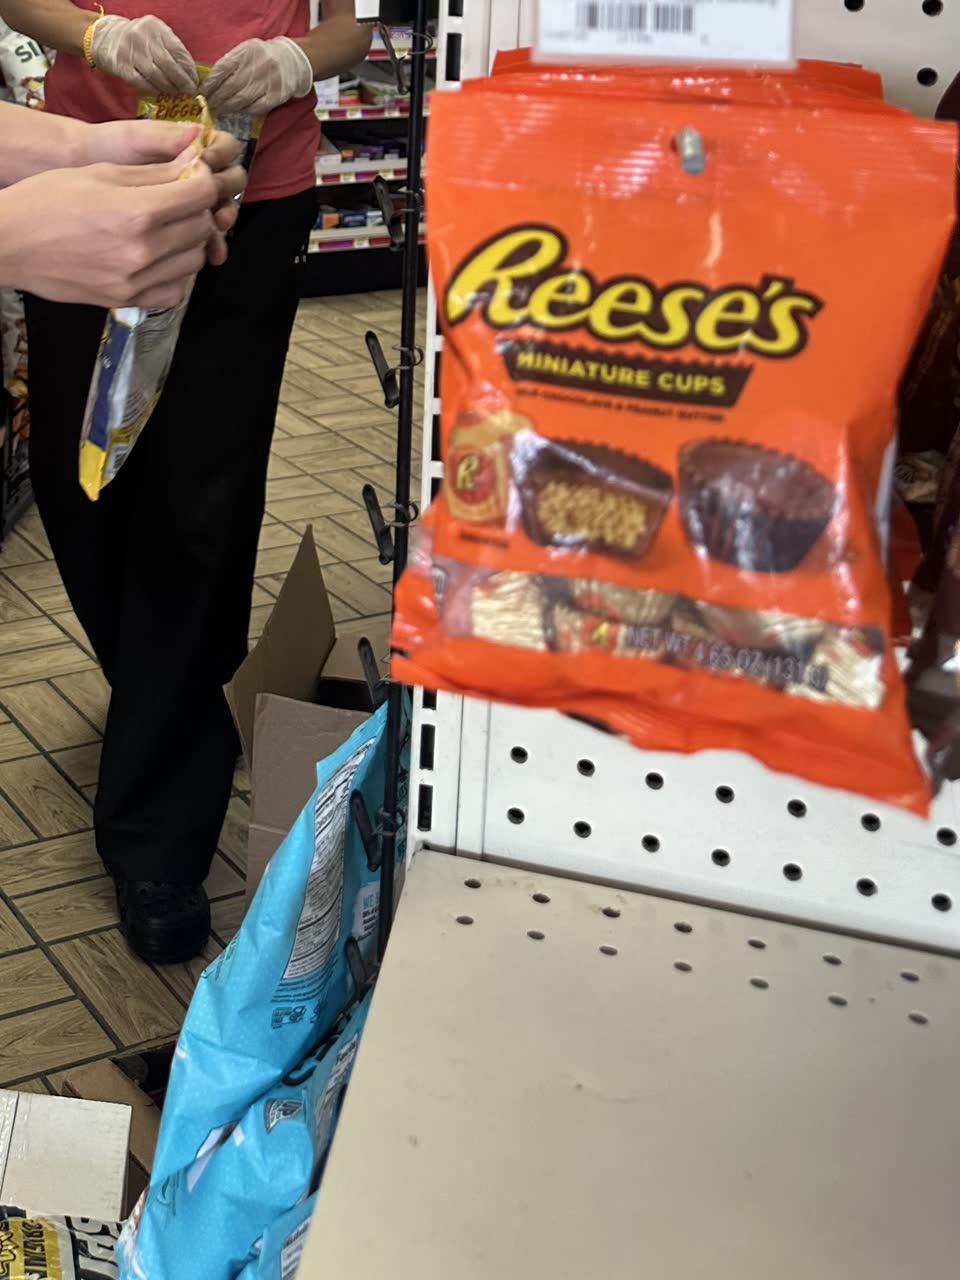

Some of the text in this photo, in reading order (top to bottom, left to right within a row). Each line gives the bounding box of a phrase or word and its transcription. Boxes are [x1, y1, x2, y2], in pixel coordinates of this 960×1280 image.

[445, 226, 820, 354] Reese's
[517, 350, 727, 397] MINIATURE CUPS
